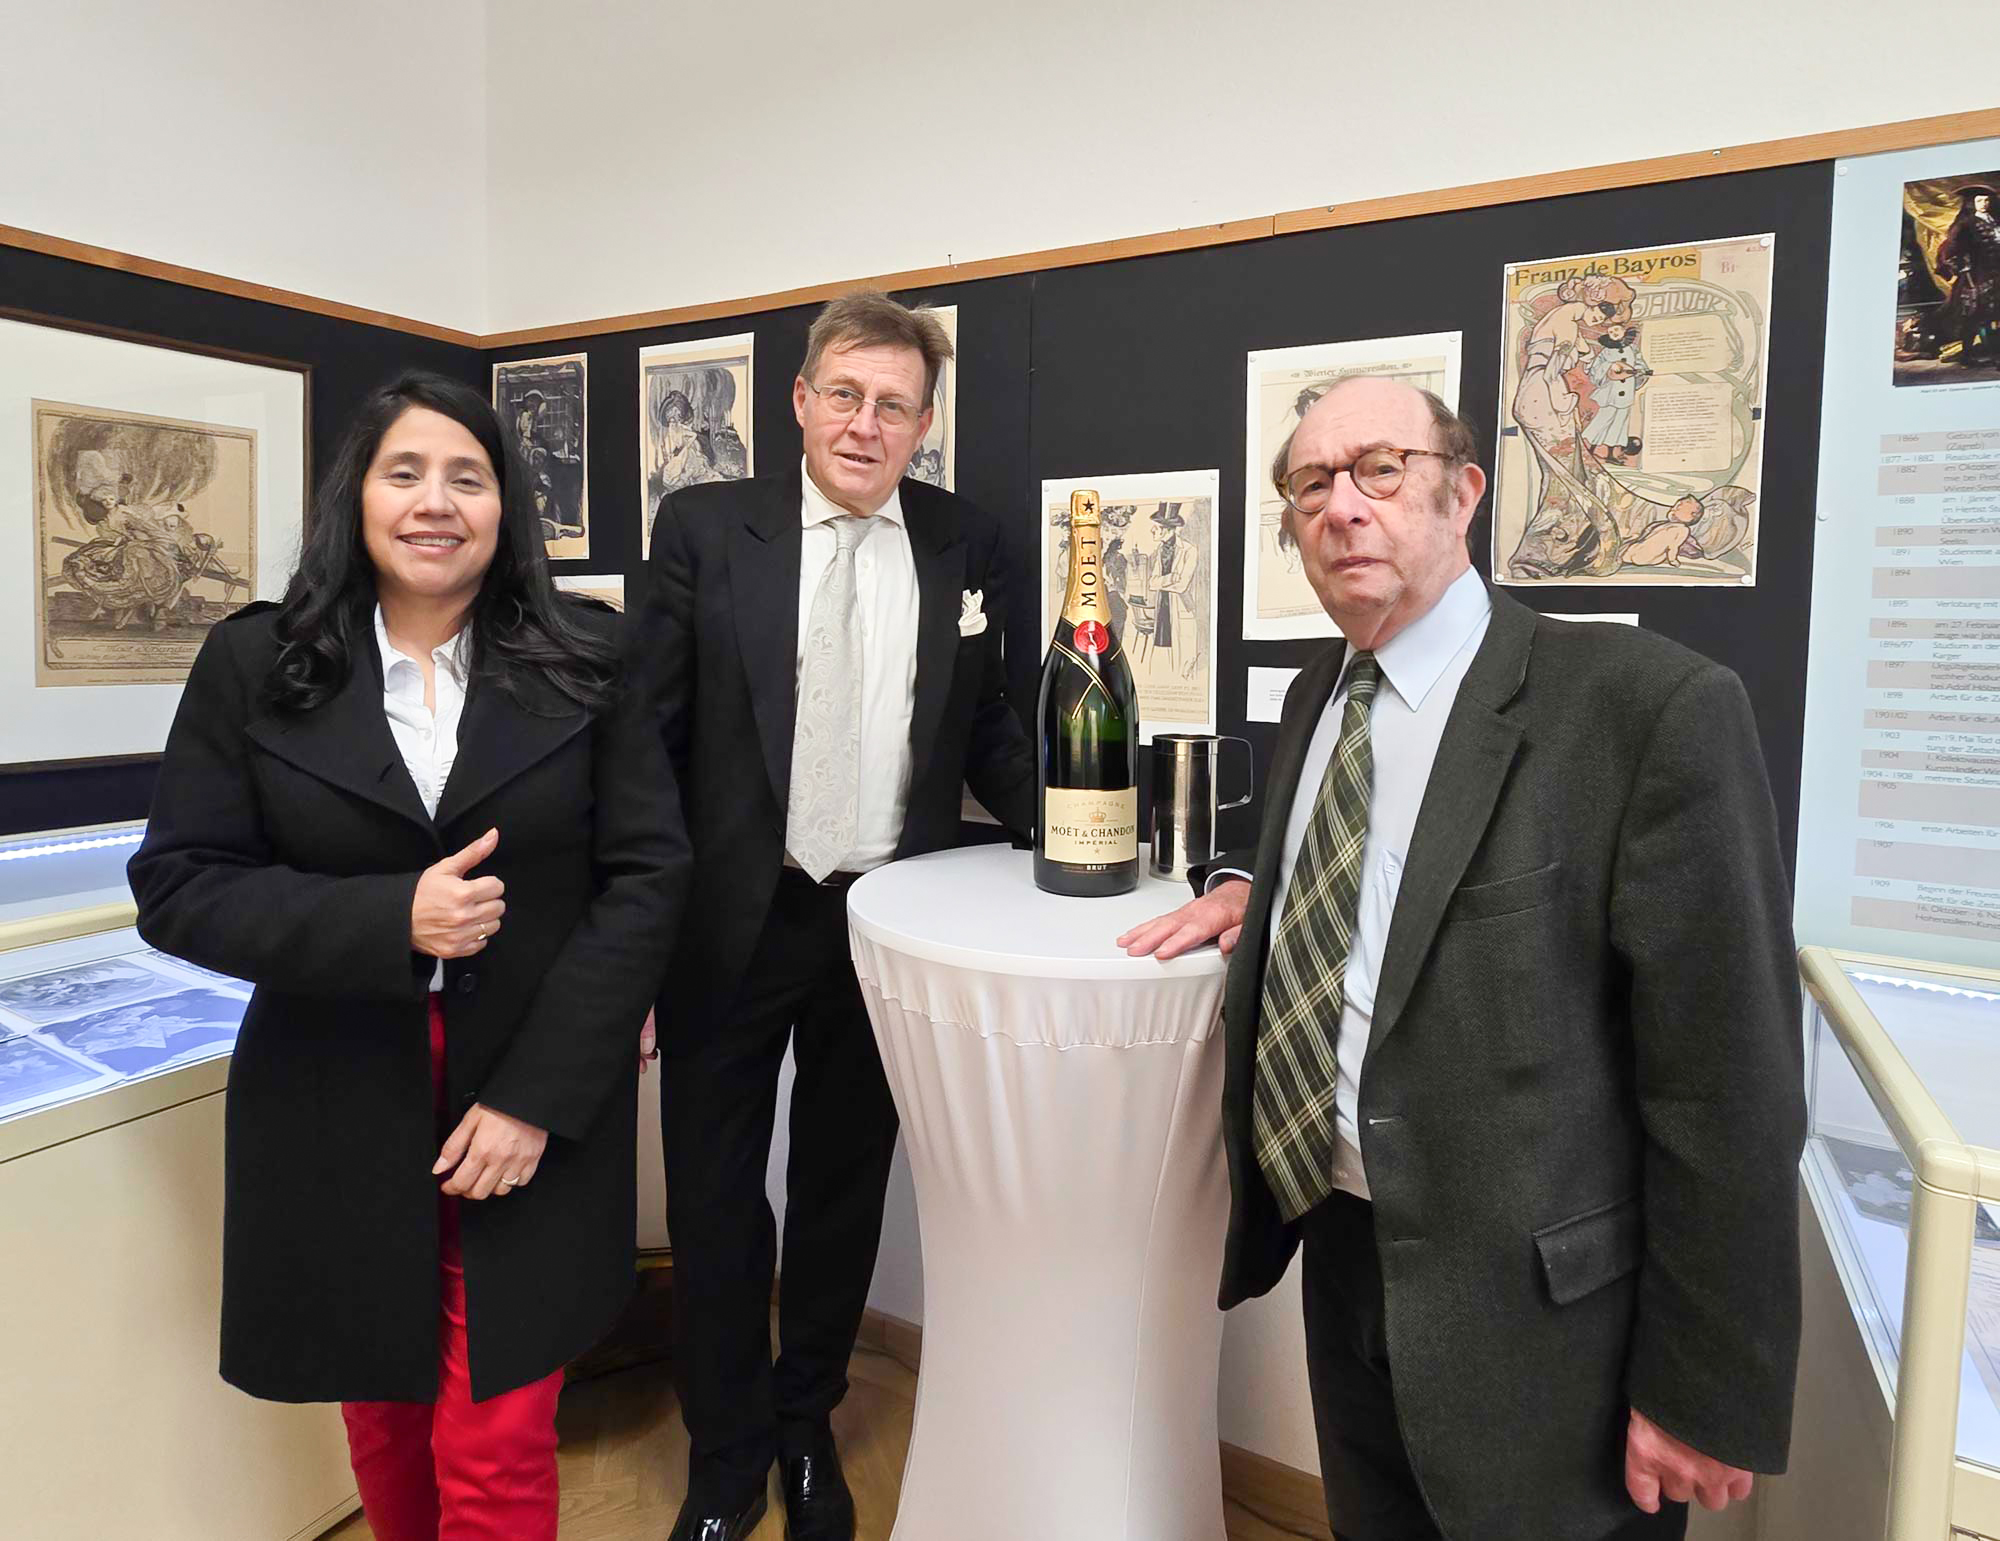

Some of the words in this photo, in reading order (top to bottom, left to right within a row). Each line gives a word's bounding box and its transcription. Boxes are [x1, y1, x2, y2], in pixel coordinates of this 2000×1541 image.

[1514, 267, 1578, 285] Franz
[1584, 260, 1609, 275] de
[1614, 253, 1697, 274] Bayros
[1881, 455, 1902, 463] 1877
[1893, 528, 1915, 537] 1890
[1940, 526, 1979, 535] Sommer
[1938, 557, 1964, 566] Wien
[1890, 569, 1912, 577] 1894
[1888, 600, 1910, 608] 1895
[1883, 661, 1905, 669] 1897
[1883, 691, 1904, 699] 1898
[1880, 731, 1901, 739] 1903
[1880, 751, 1900, 759] 1904
[1863, 769, 1883, 778] 1904
[1893, 772, 1914, 780] 1908
[1877, 781, 1897, 790] 1905
[1082, 830, 1088, 838] &
[1090, 825, 1135, 838] CHANDON
[1875, 820, 1896, 830] 1906
[1945, 826, 1985, 837] Arbeiten
[1870, 879, 1891, 888] 1909
